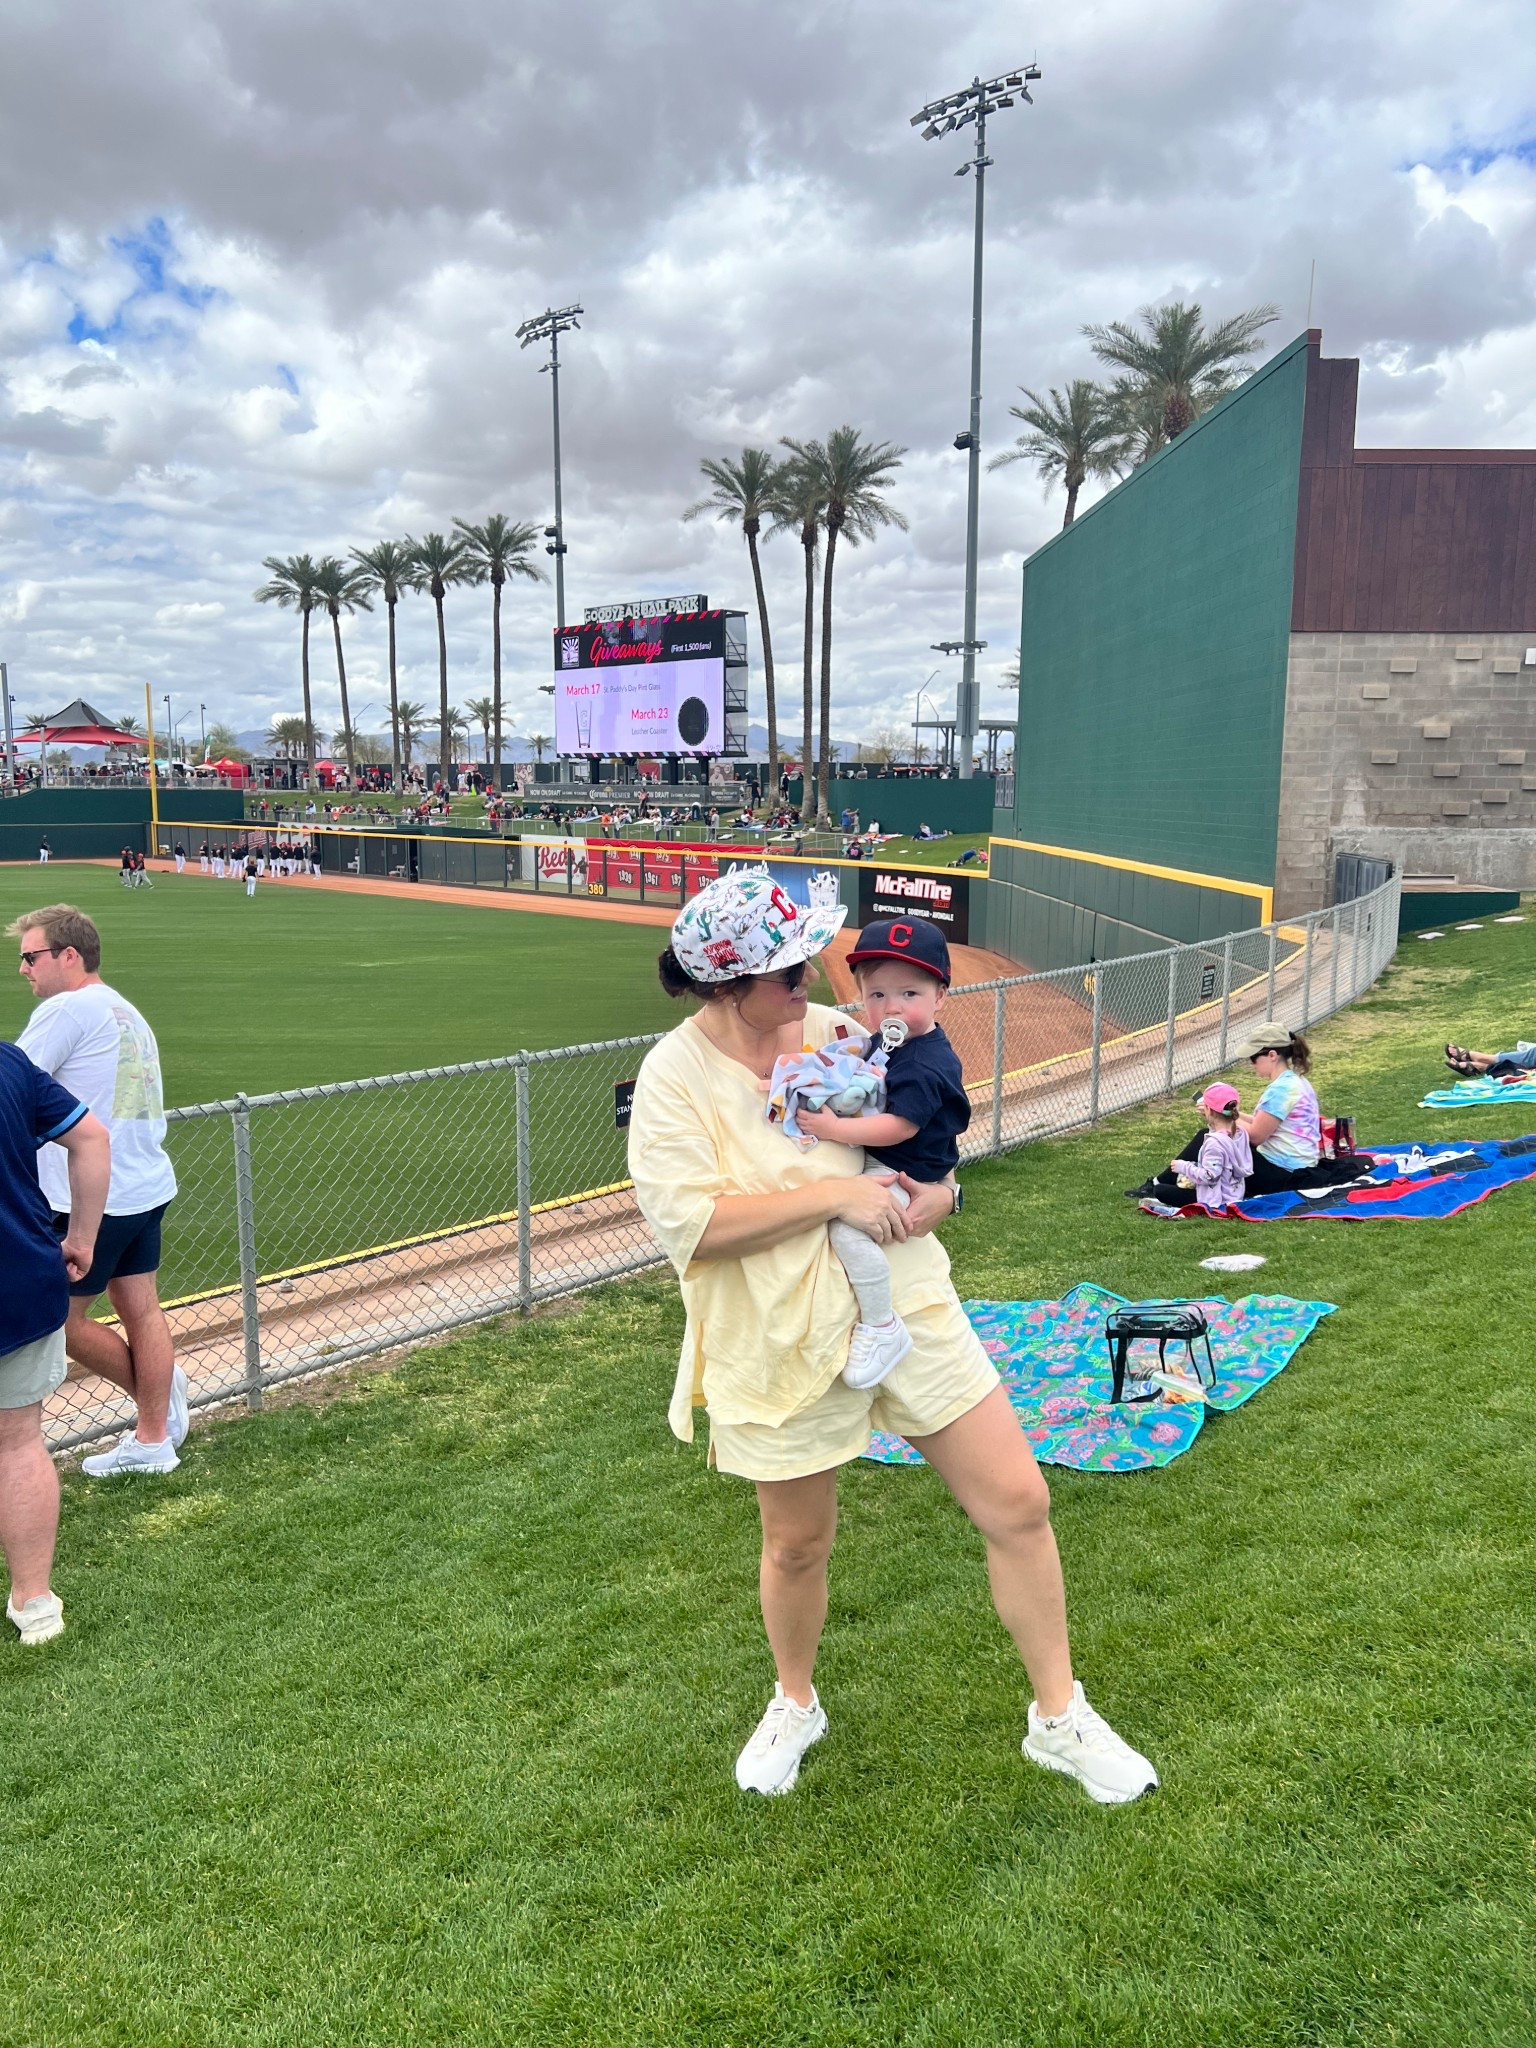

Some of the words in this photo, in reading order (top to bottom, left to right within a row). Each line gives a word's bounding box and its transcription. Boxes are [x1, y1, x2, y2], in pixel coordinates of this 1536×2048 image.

[584, 604, 640, 622] GOODYEAR
[590, 636, 664, 667] Giveaways
[566, 685, 589, 696] March
[591, 683, 600, 695] 17
[610, 685, 628, 693] Paddy's
[628, 684, 637, 692] Day
[631, 709, 656, 720] March
[658, 707, 669, 719] 23
[537, 840, 579, 875] Reds
[644, 871, 658, 886] 1961
[588, 883, 604, 895] 380
[875, 875, 953, 900] McFallTire
[770, 885, 797, 921] C
[907, 907, 930, 918] GOODYEAR
[888, 923, 914, 948] C
[616, 1104, 633, 1115] STAN
